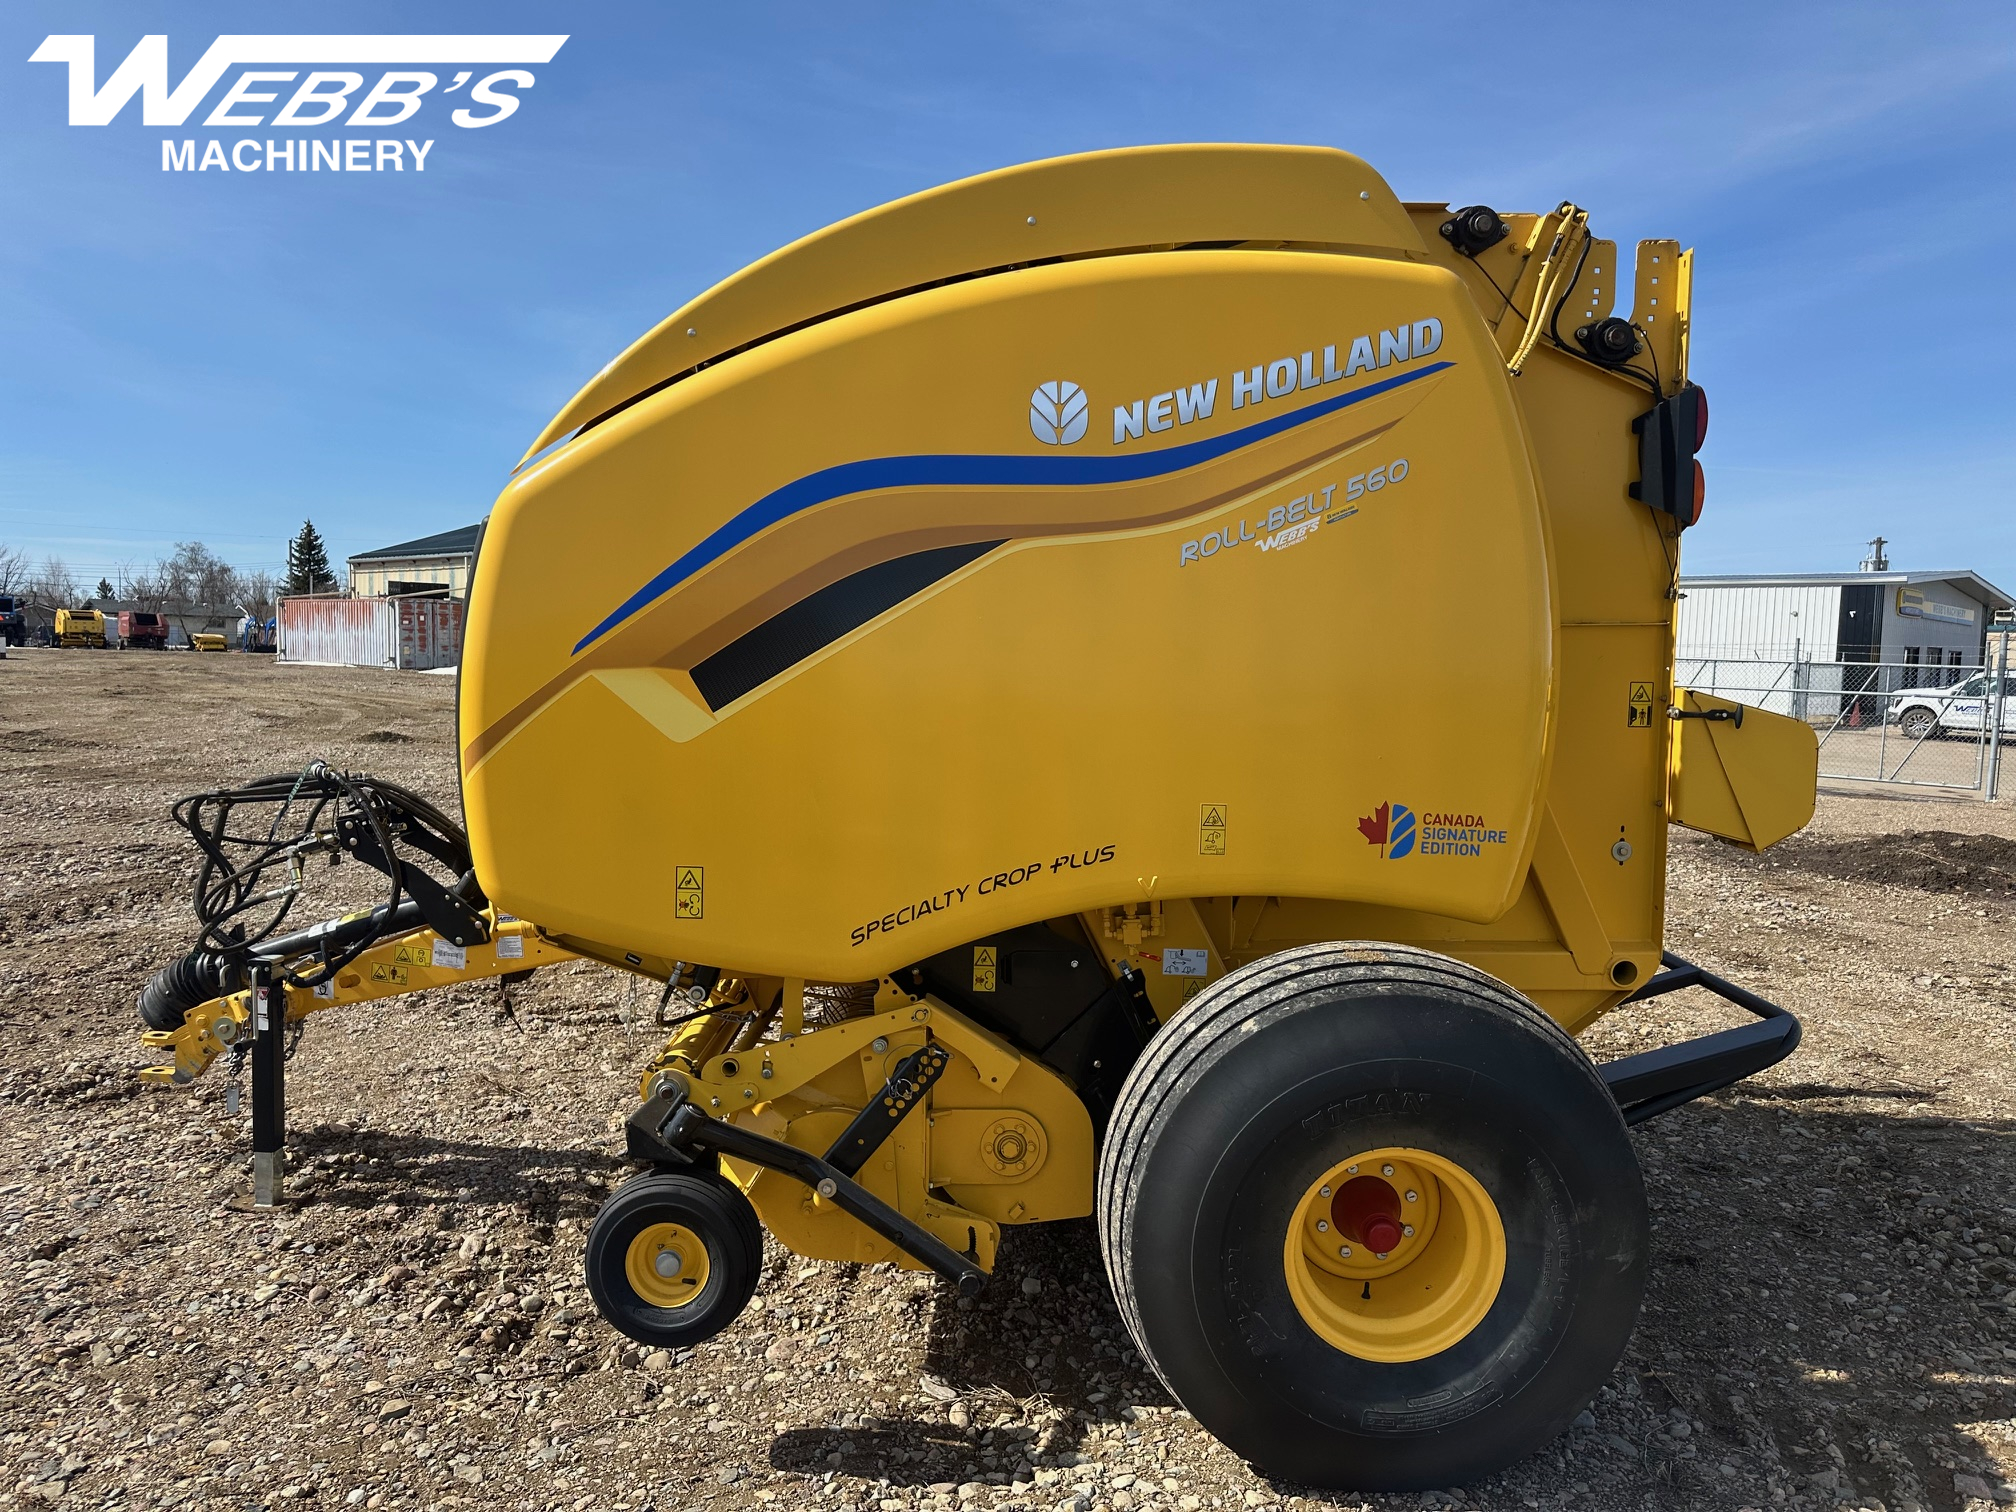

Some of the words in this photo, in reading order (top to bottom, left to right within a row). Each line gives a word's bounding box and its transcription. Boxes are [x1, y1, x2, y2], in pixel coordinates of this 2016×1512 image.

[1112, 377, 1219, 446] NEW
[1231, 316, 1445, 411] HOLLAND
[1179, 483, 1338, 568] ROLL-BELT
[1346, 458, 1410, 501] 560
[1254, 515, 1322, 552] WEBB'S
[1422, 812, 1486, 829] CANADA
[1422, 827, 1508, 844] SIGNATURE
[1420, 841, 1481, 858] EDITION
[850, 883, 971, 948] SPECIALTY
[978, 861, 1042, 896] CROP
[1301, 1091, 1433, 1141] TITAN
